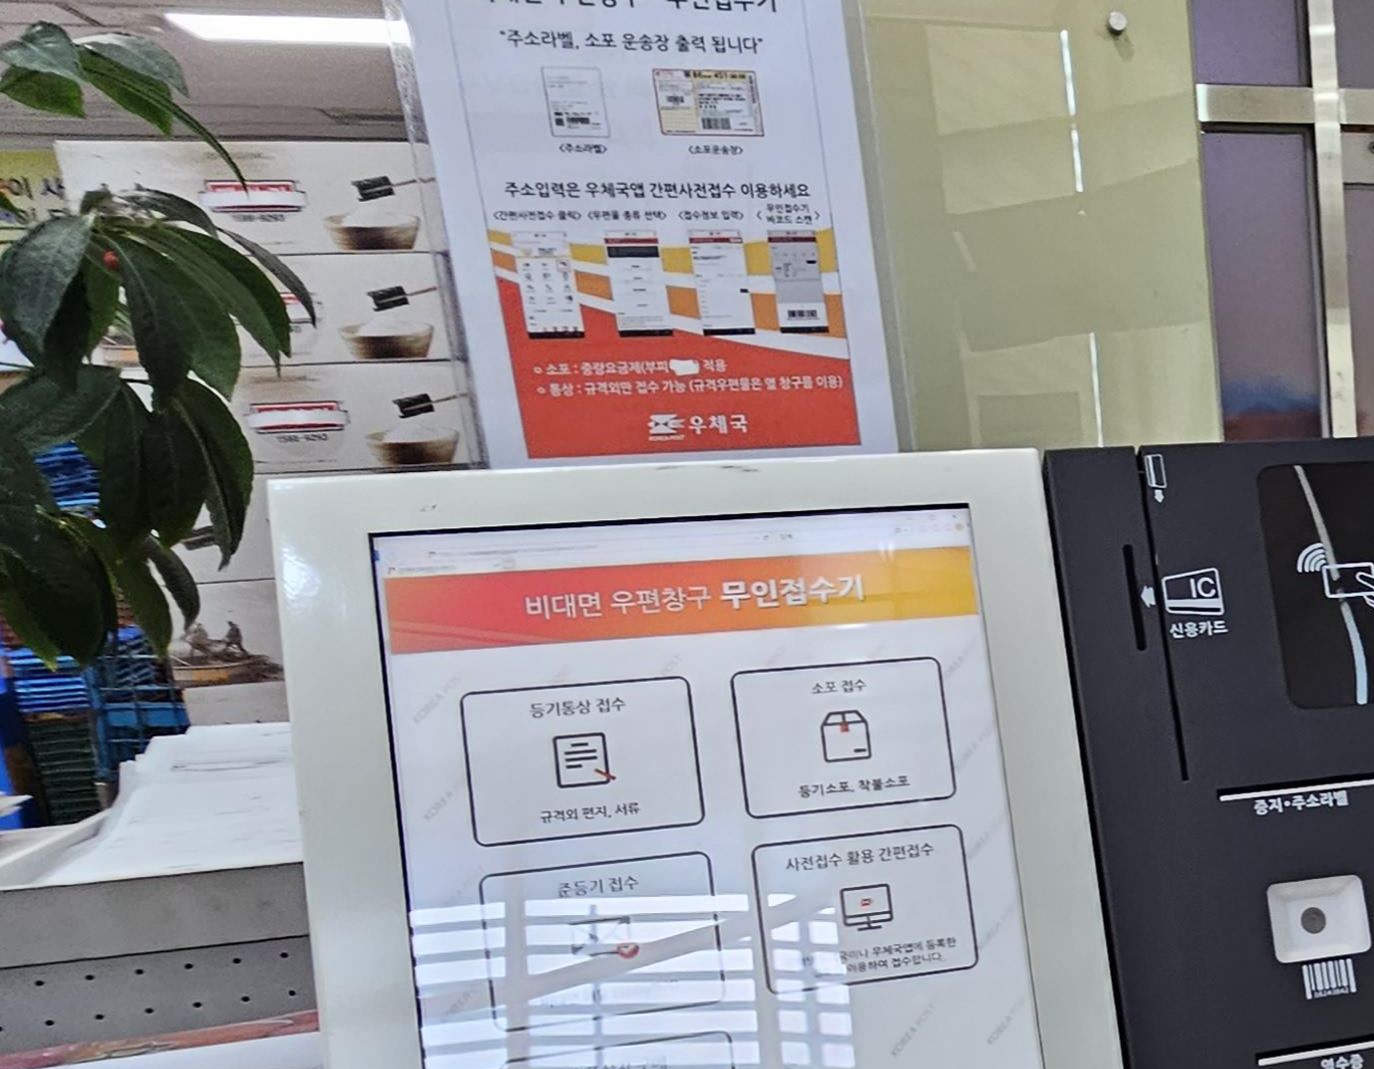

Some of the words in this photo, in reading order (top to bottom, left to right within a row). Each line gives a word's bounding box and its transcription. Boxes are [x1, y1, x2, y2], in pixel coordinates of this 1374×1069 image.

[585, 34, 617, 49] 소포
[622, 34, 670, 52] 운송장
[676, 34, 707, 52] 출력
[504, 182, 581, 199] 주소입력은
[584, 182, 646, 199] 우체국앱
[649, 183, 737, 199] 간편사전접수
[740, 183, 812, 199] 이용하세요
[689, 413, 749, 435] 우체국
[525, 588, 603, 621] 비대면
[610, 584, 711, 618] 우편창구
[719, 573, 866, 611] 무인접수기
[1189, 577, 1217, 600] IC
[1169, 620, 1229, 641] 신용카드
[811, 680, 835, 696] 소포
[838, 677, 868, 695] 접수
[529, 699, 592, 720] 등기통상
[595, 695, 627, 716] 접수
[798, 781, 854, 801] 등기소포,
[857, 774, 911, 794] 착불소포
[539, 808, 580, 825] 규격외
[614, 801, 641, 819] 서류
[785, 851, 844, 873] 사전접수
[846, 848, 874, 869] 활용
[877, 841, 935, 864] 간편접수
[608, 875, 640, 893] 접수
